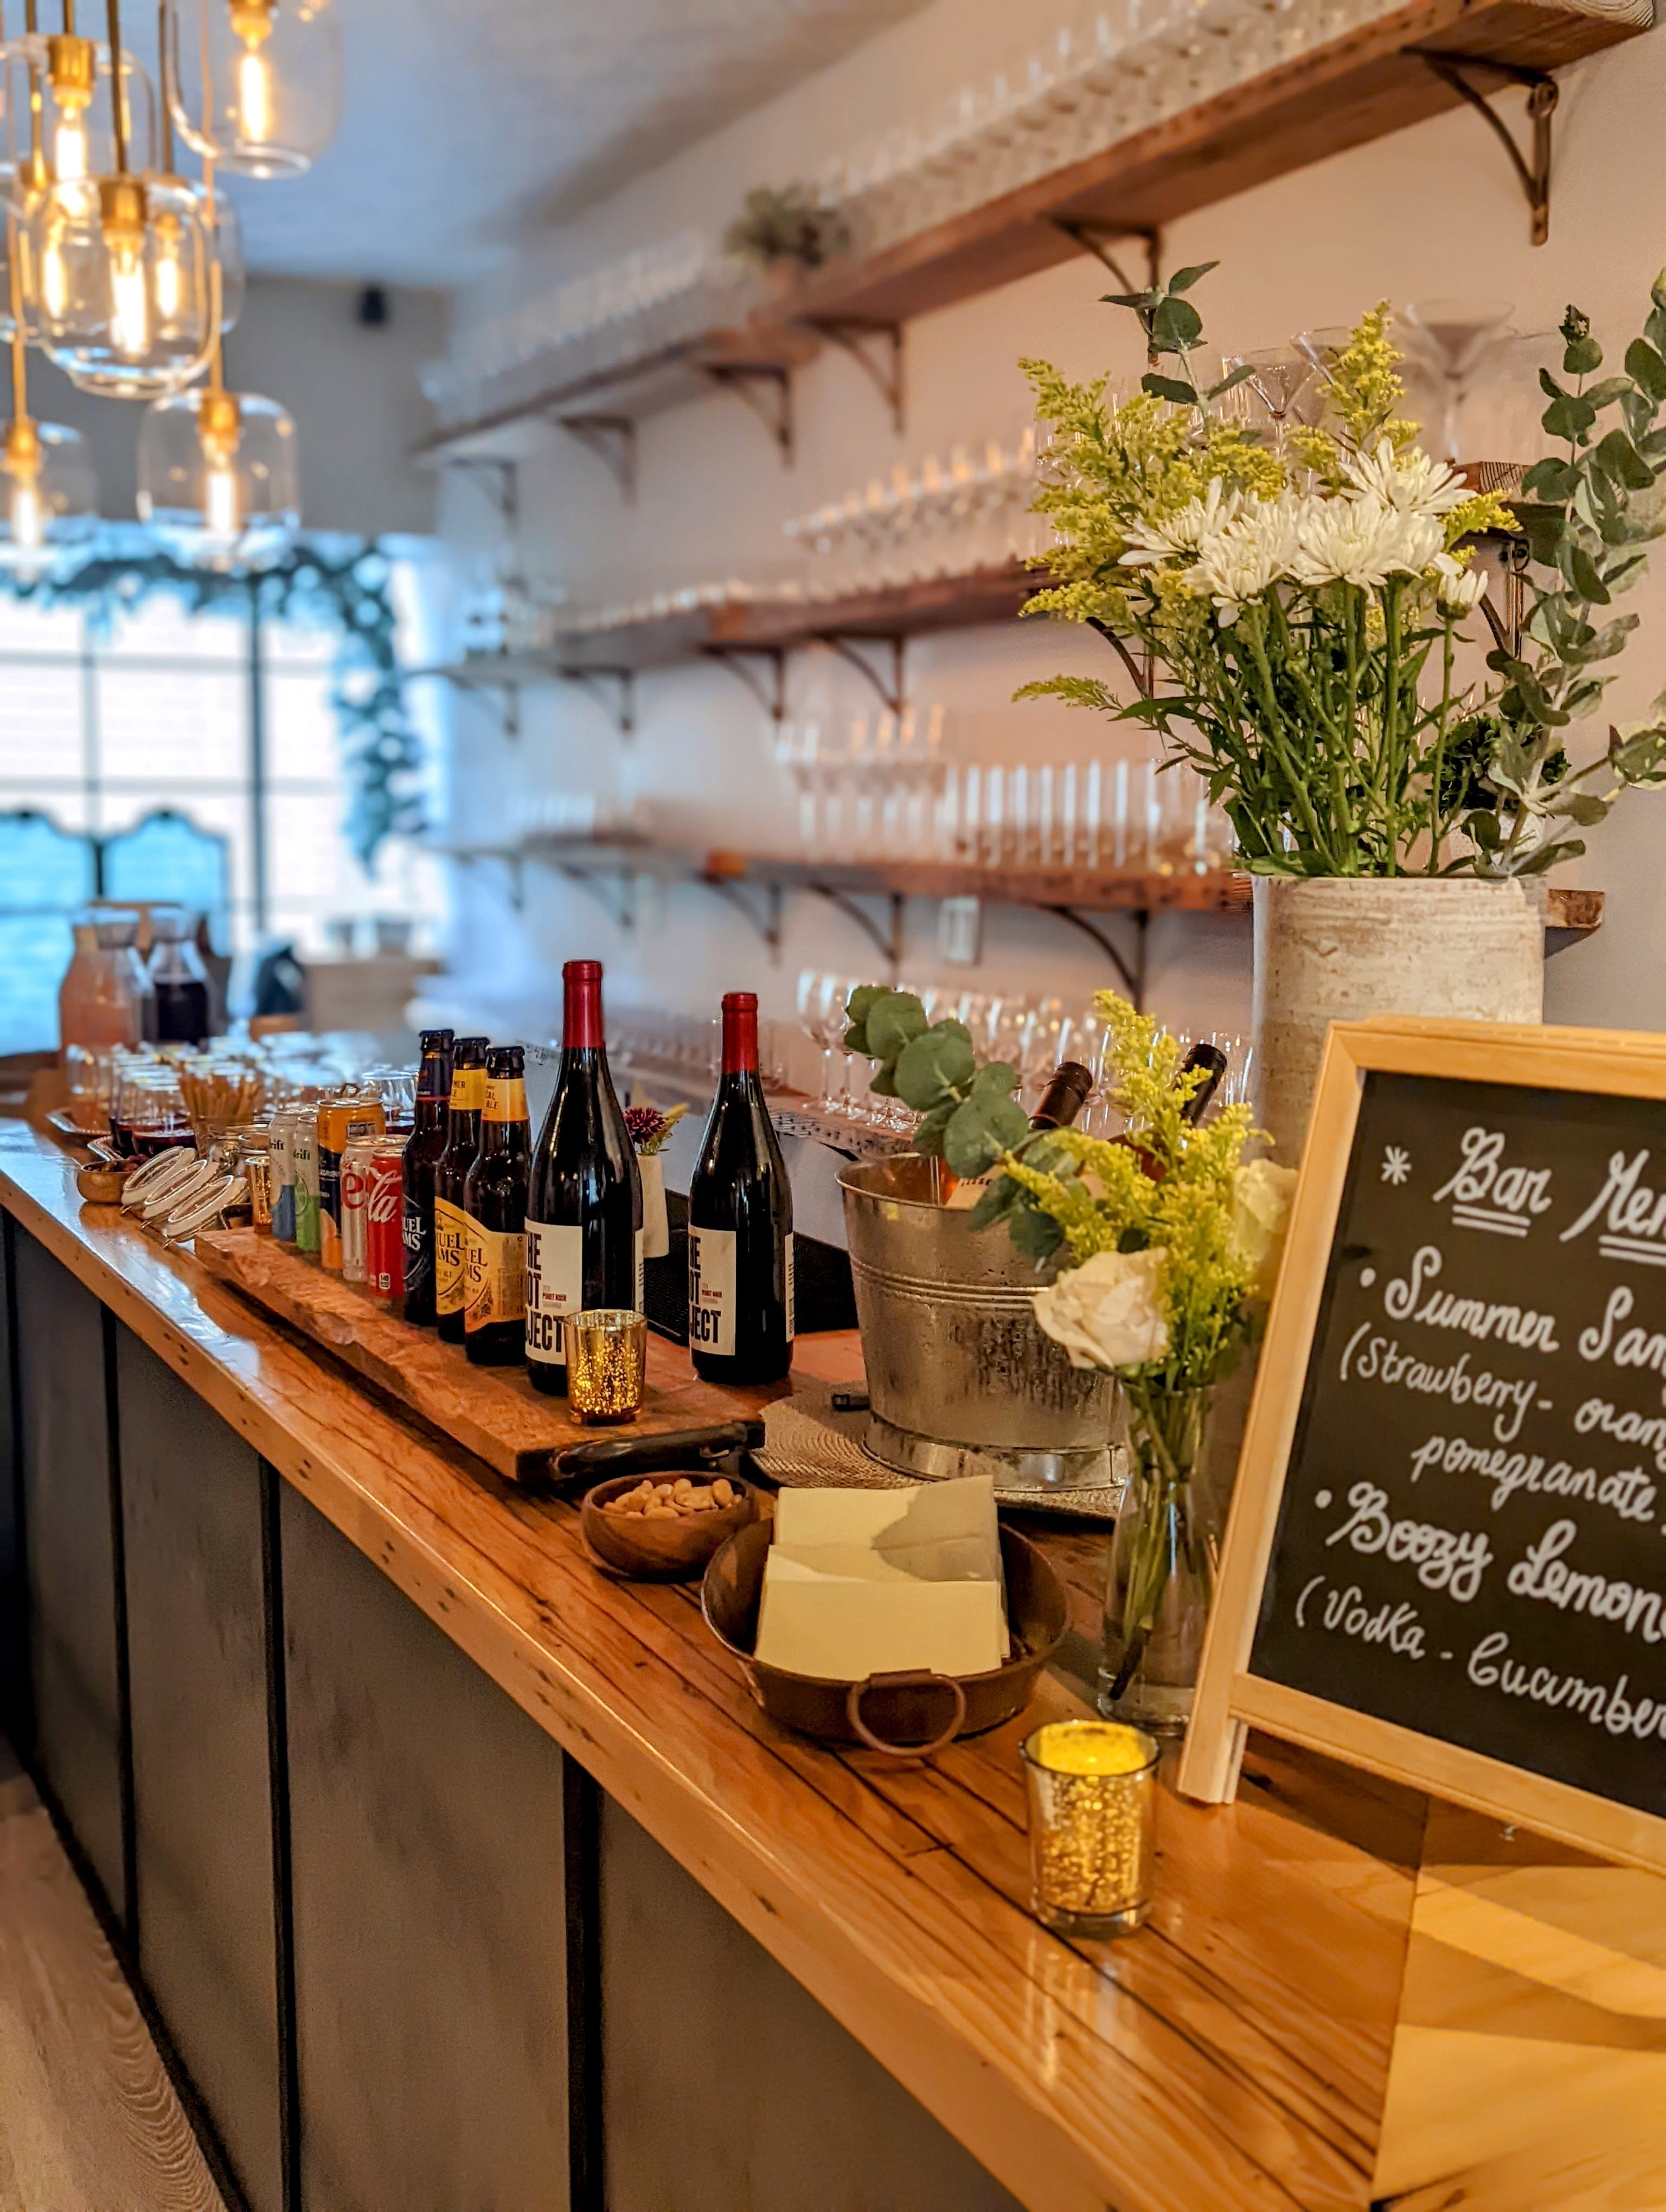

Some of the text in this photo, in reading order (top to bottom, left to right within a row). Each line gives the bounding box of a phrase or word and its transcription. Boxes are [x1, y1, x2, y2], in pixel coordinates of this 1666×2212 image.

[1433, 1127, 1552, 1213] Bar
[436, 1232, 465, 1251] UEL
[1384, 1246, 1666, 1405] Summer San
[1574, 1398, 1666, 1472] oran
[1411, 1436, 1657, 1521] pomegranate
[1326, 1482, 1666, 1643] Boozy Lemon
